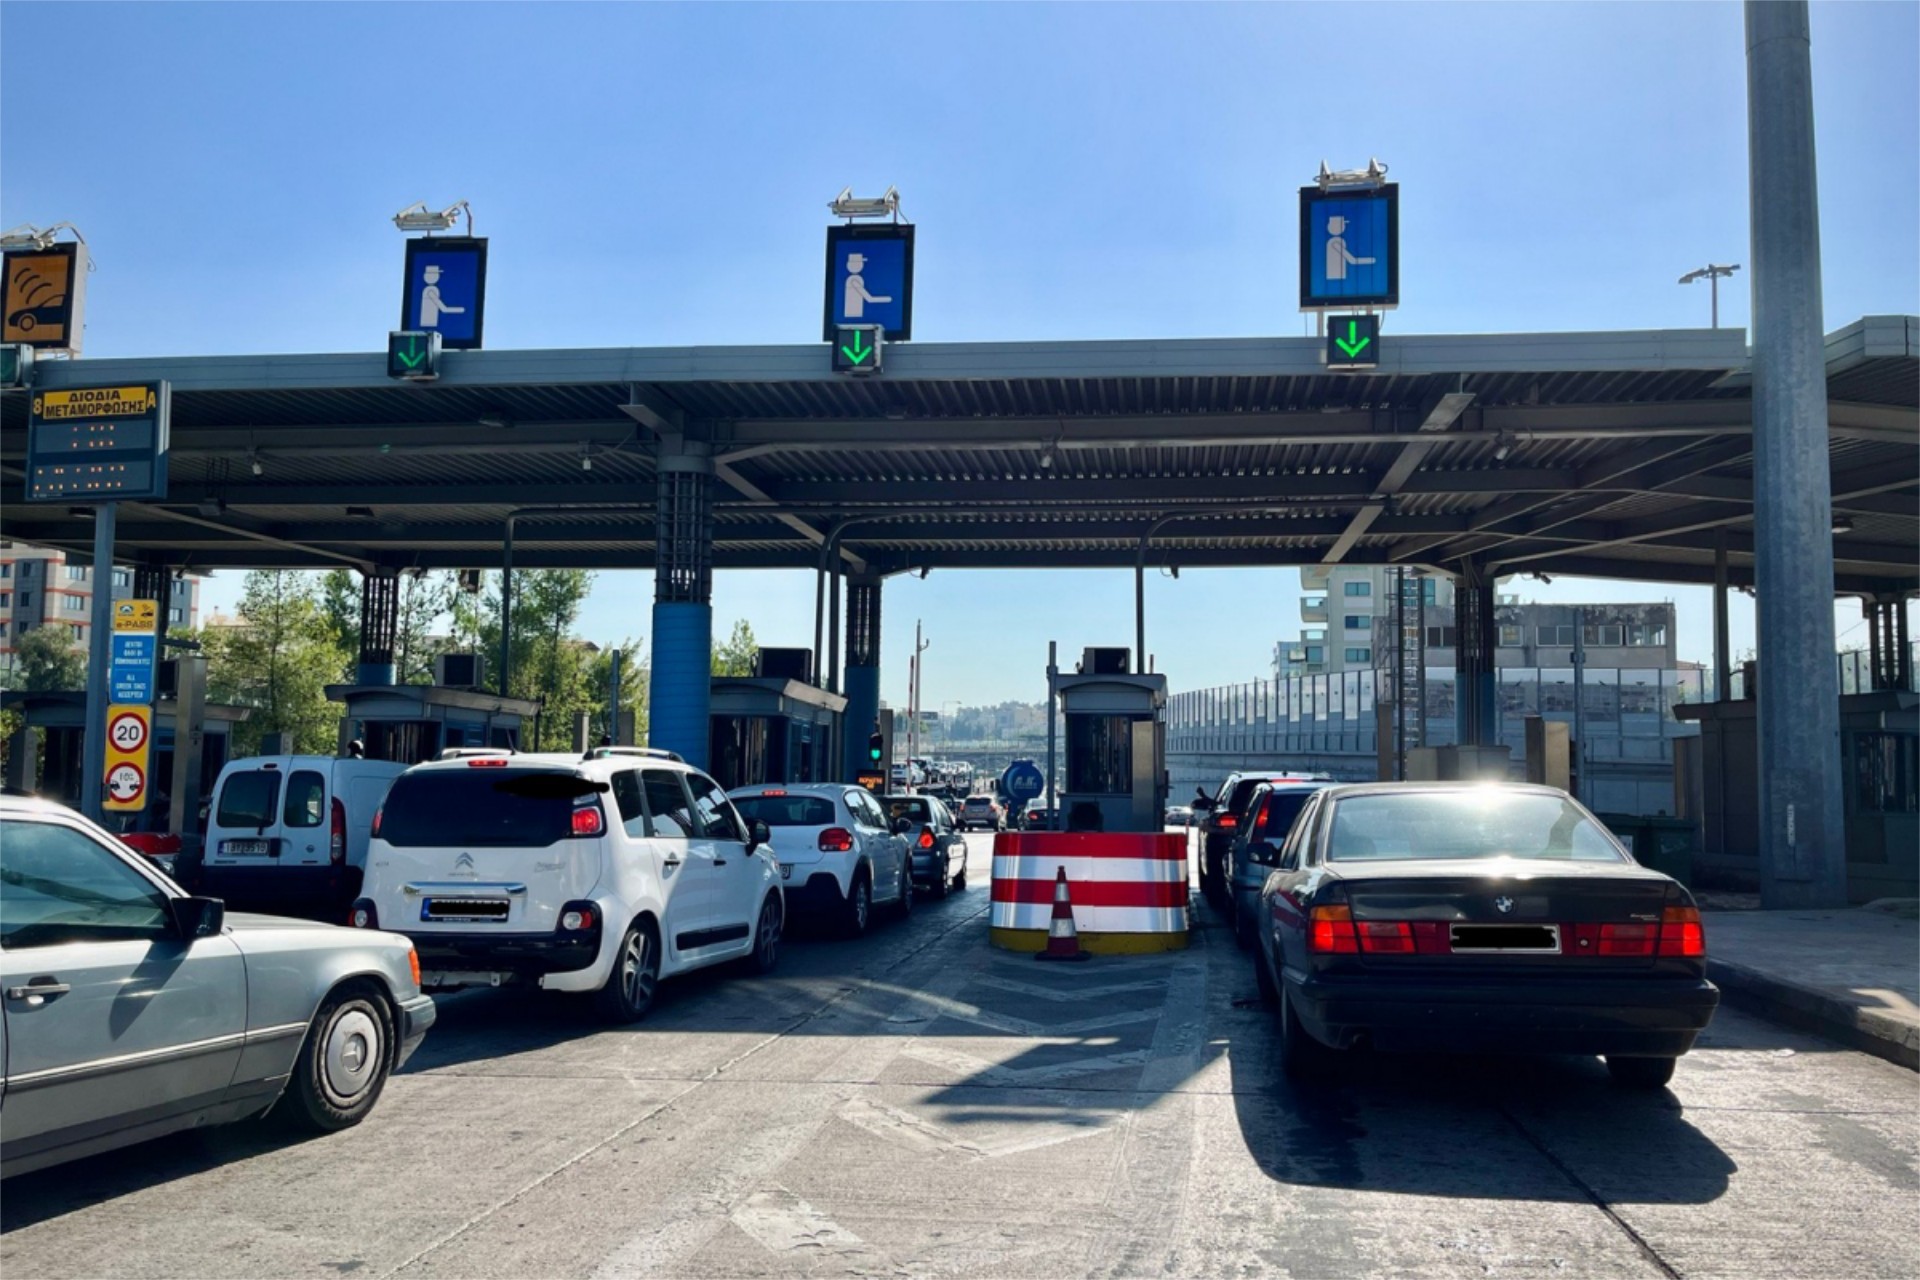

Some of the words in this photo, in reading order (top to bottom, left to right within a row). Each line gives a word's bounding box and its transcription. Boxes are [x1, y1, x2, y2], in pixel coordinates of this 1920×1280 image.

[69, 391, 121, 402] ΔΙΟΔΙΑ
[46, 400, 144, 416] ΜΕΤΑΜΟΡΦΩΣΗΣ
[117, 725, 140, 742] 20
